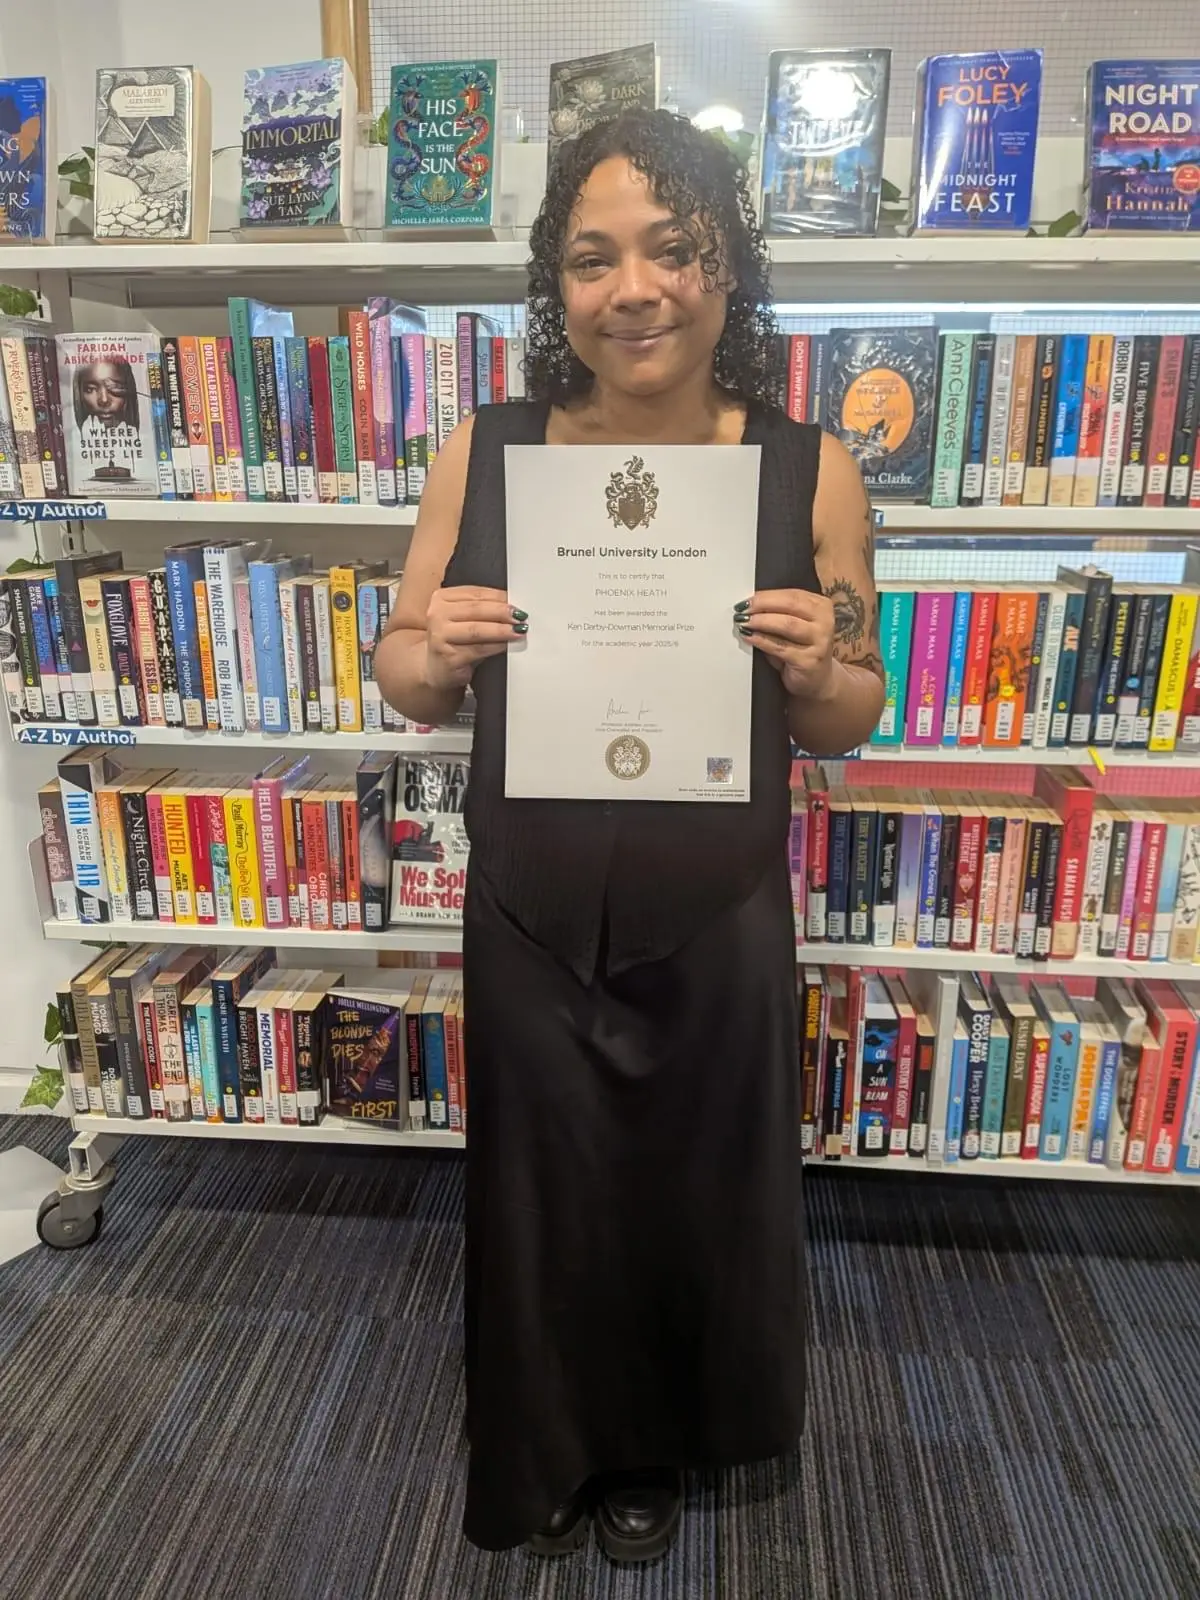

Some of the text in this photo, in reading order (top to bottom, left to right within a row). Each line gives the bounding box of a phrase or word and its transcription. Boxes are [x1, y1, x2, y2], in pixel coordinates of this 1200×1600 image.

[960, 66, 1010, 82] LUCY
[426, 100, 457, 116] HIS
[612, 84, 646, 100] DARK
[938, 82, 1027, 106] FOLEY
[1105, 84, 1198, 106] NIGHT
[246, 120, 338, 150] IMMORTAL
[418, 122, 464, 138] FACE
[1109, 112, 1192, 134] ROAD
[426, 144, 454, 152] IS THE
[420, 158, 456, 174] SUN
[940, 174, 1017, 186] MIDNIGHT
[262, 191, 320, 206] SUE LYNN
[279, 205, 302, 217] TAN
[934, 192, 1016, 213] FEAST
[1106, 194, 1189, 212] Hannah
[77, 343, 126, 352] FARIDAH
[183, 353, 201, 415] POWER
[204, 344, 221, 418] DOLLY ALDERTON
[355, 322, 368, 429] WILD HOUSES COLIN
[439, 343, 454, 398] ZOO CITY
[1137, 362, 1150, 386] FIVE
[167, 355, 182, 427] THE WHITE TIGER
[223, 384, 231, 411] KNOWS
[944, 340, 966, 450] Ann Cleeves
[1109, 341, 1130, 446] ROBIN COOK MANNER
[334, 377, 351, 463] SIEGE STORM
[426, 392, 434, 425] BROWN
[1037, 394, 1048, 443] HUNGER
[1132, 390, 1145, 438] BROKEN
[80, 438, 142, 448] SLEEPING
[89, 428, 133, 438] WHERE
[244, 394, 257, 460] ZAINA ARAFAT
[82, 450, 143, 460] GIRLS LIE
[878, 472, 913, 484] Clarke
[0, 503, 105, 519] -Z by Author
[557, 547, 707, 559] Brunel University London
[28, 586, 37, 612] GAYLE
[208, 561, 227, 647] THE WAREHOUSE
[595, 589, 667, 597] PHOENIX HEATH
[13, 589, 26, 634] SMALL RIVERS
[106, 594, 128, 646] FOXGLOVE
[154, 579, 170, 658] GUAPA
[197, 596, 209, 637] EXIT WEST
[259, 602, 270, 633] AUSTEN
[568, 623, 582, 631] Ken
[583, 623, 641, 632] Darby-Dowman
[954, 597, 967, 659] SARAH MAAS
[1005, 607, 1015, 635] MAAS
[1017, 600, 1027, 634] SARAH
[134, 586, 156, 678] THE RABBIT TESS
[171, 561, 192, 699] MARK HADDON THE PORPOISE
[889, 597, 900, 660] SARAH MAAS
[927, 597, 940, 660] SARAH MAAS
[975, 597, 990, 660] SARAH MAAS
[1112, 602, 1128, 658] PETER MAY
[306, 644, 313, 655] GO
[1166, 638, 1183, 692] DAMASCUS
[218, 660, 230, 679] ROB
[20, 730, 136, 745] A-Z by Author
[66, 793, 100, 887] THIN AIR
[131, 817, 146, 854] Night
[165, 804, 186, 855] HUNTED
[234, 804, 246, 849] Paul Murray
[258, 788, 278, 882] HELLO BEAUTIFUL
[1034, 828, 1042, 848] SALLY
[76, 829, 85, 861] MORGAN
[82, 828, 92, 860] RICHARD
[960, 833, 970, 863] RITCHIE
[1144, 829, 1160, 889] THE CHRISTMAS
[401, 866, 428, 888] We
[856, 840, 868, 882] PRATCHETT
[927, 831, 940, 894] When The Cranes
[1062, 858, 1079, 896] SALMAN
[91, 1002, 101, 1035] MUNGO
[99, 1004, 109, 1033] YOUNG
[156, 998, 167, 1033] THOMAS
[166, 992, 178, 1034] SCARLETT
[336, 1010, 360, 1022] THE
[356, 1001, 390, 1014] WELLINGTON
[239, 1011, 250, 1070] BRIGHT HAVEN
[260, 1013, 273, 1071] MEMORIAL
[330, 1025, 374, 1040] BLONDE
[969, 1014, 983, 1063] COOPER
[980, 1014, 990, 1062] DAISY MAY
[147, 1046, 156, 1063] CODE
[162, 1060, 182, 1070] THE
[331, 1044, 365, 1060] DIES
[1012, 1020, 1029, 1080] SUSIE DENT
[1079, 1045, 1097, 1088] JOHN
[124, 1043, 135, 1094] DOUGLAS STUART
[164, 1070, 183, 1080] END
[1028, 1053, 1047, 1115] SUPERFANDOM
[1050, 1056, 1062, 1103] WONDERS
[1062, 1068, 1072, 1092] LOST
[1098, 1050, 1116, 1120] THE DOSE EFFECT
[1162, 1031, 1189, 1125] STORY MURDER
[352, 1100, 397, 1119] FIRST
